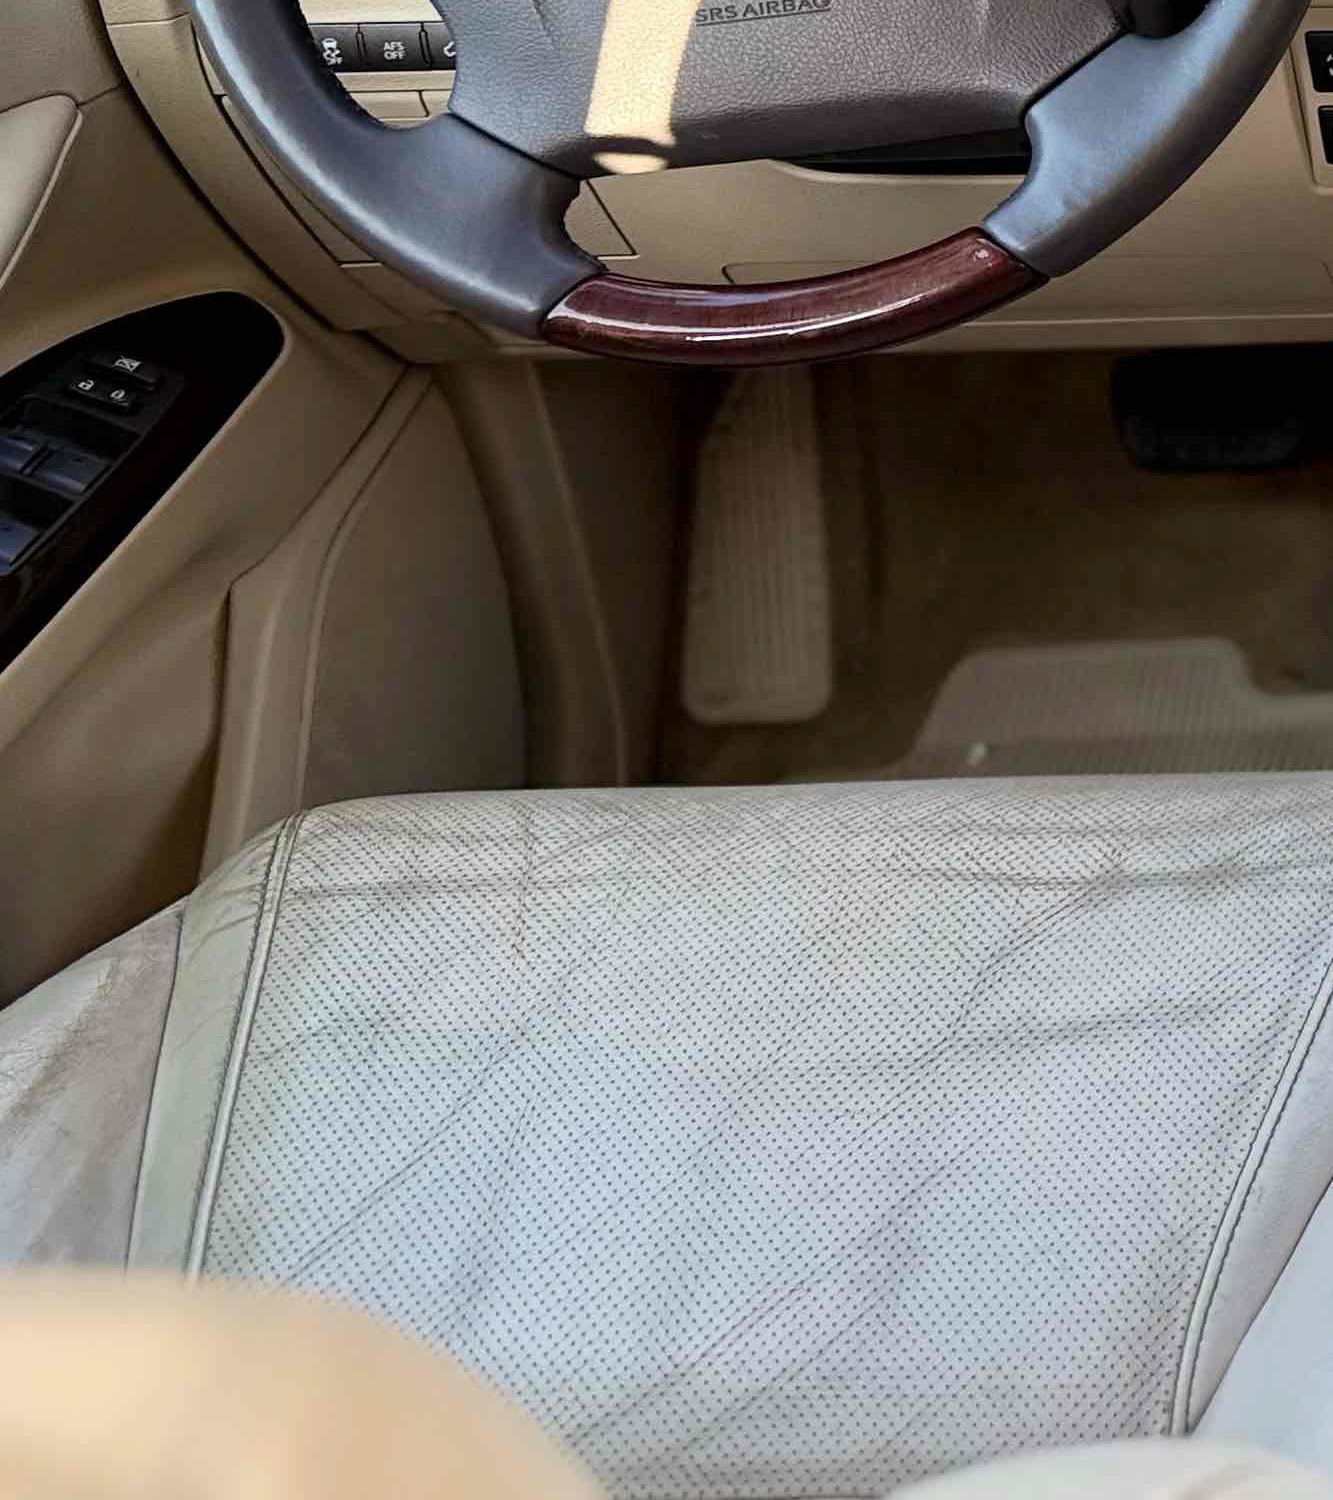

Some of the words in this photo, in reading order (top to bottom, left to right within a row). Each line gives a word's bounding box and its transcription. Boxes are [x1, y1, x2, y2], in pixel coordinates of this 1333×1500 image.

[695, 4, 738, 23] SRS
[383, 41, 405, 51] AFS
[383, 51, 405, 61] OFF
